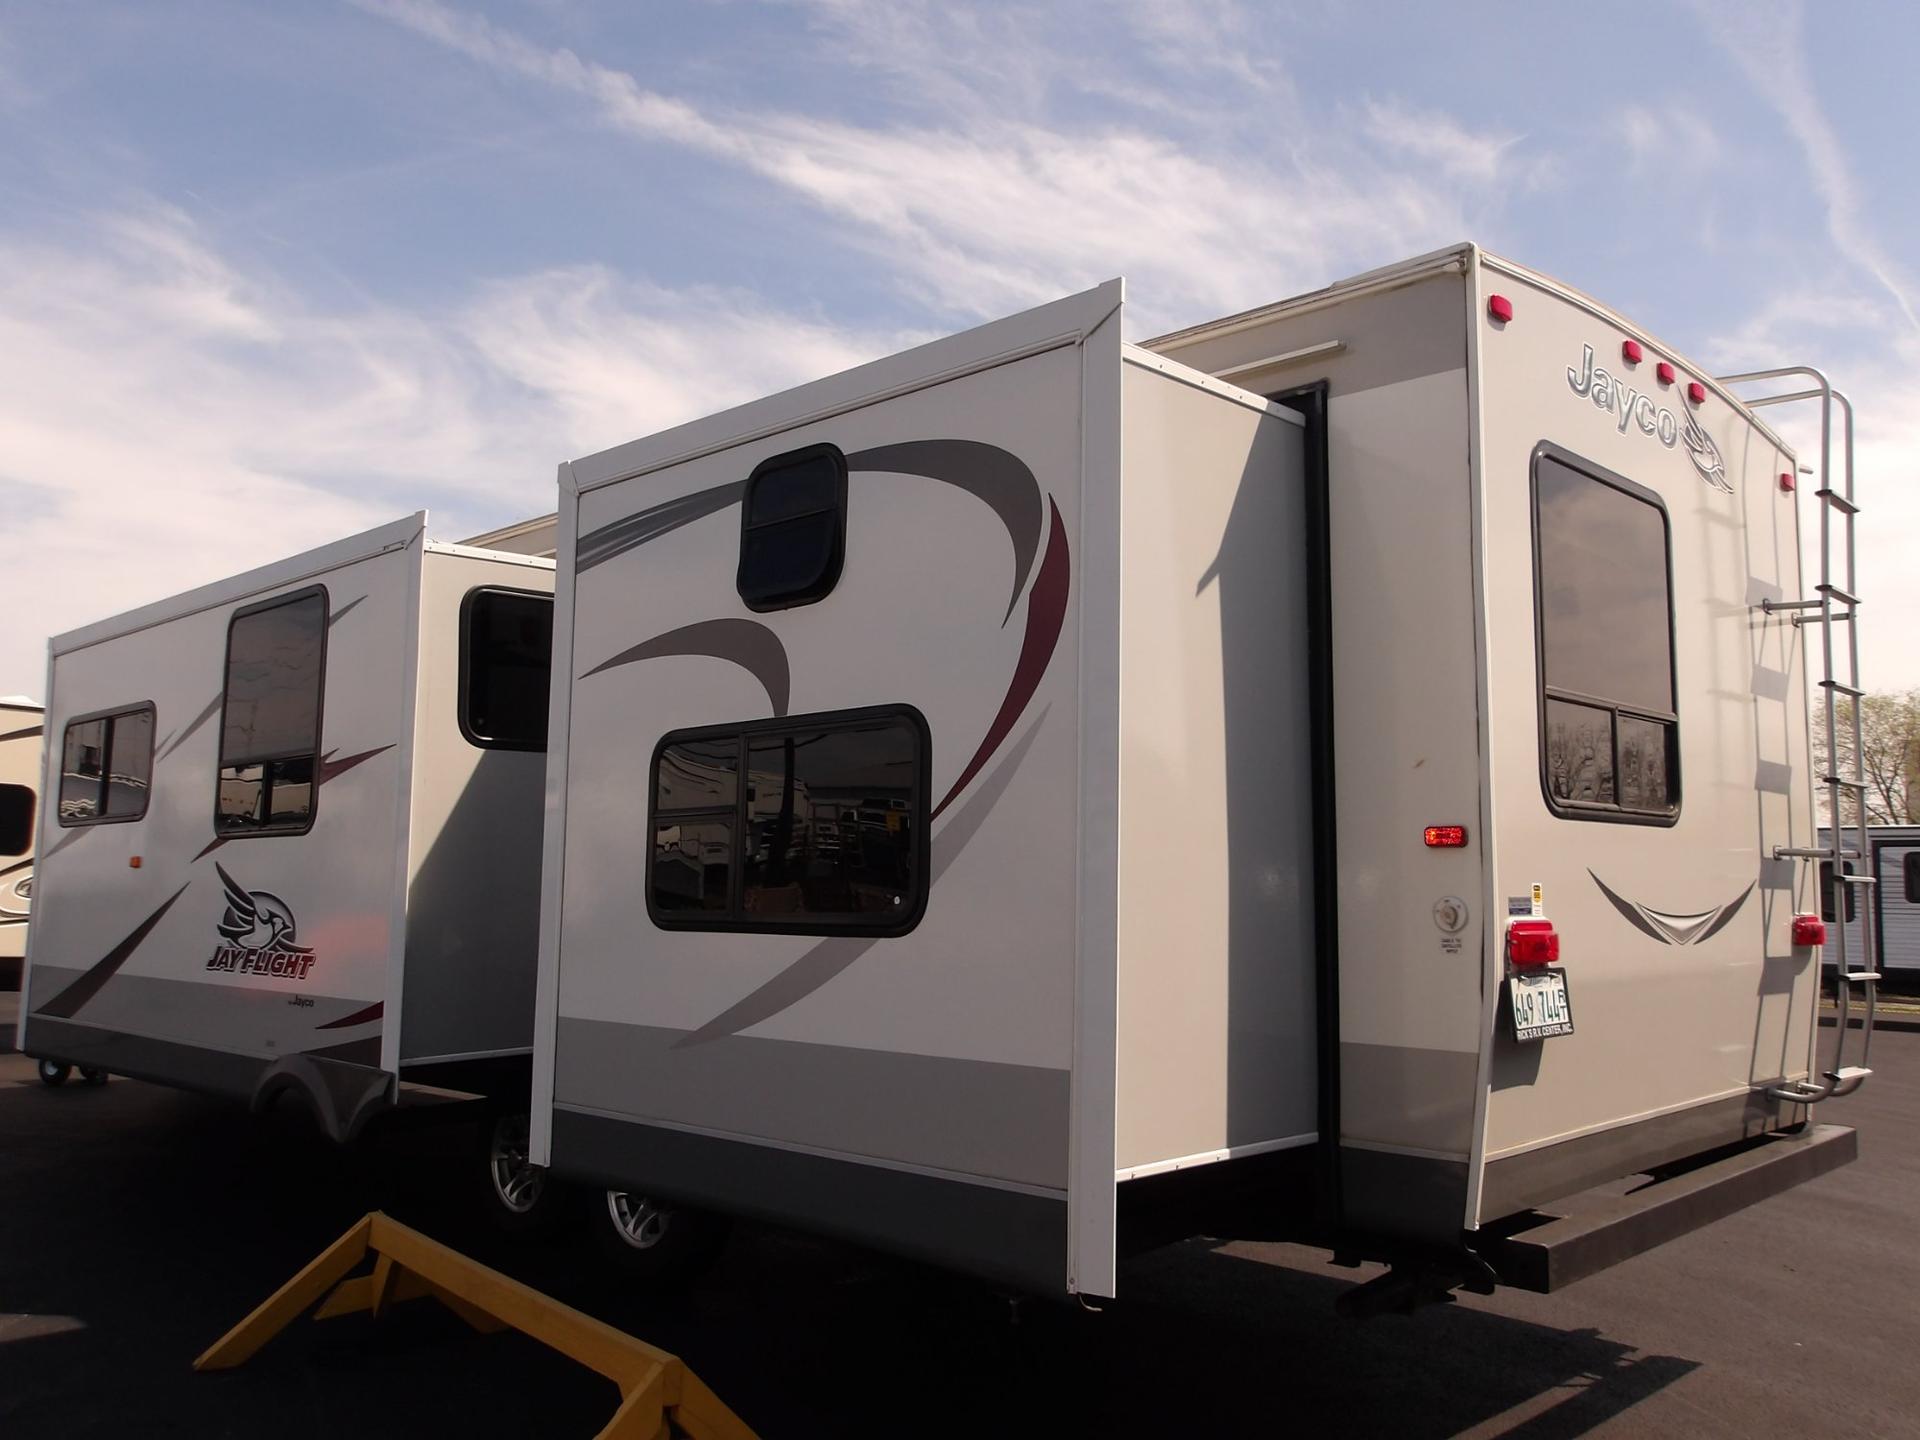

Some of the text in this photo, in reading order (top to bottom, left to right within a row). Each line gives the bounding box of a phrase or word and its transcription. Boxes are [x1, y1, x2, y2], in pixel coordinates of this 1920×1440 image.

[1567, 343, 1678, 449] Jayco
[240, 948, 316, 979] FLIGHT
[1515, 992, 1534, 1026] 649
[1538, 990, 1561, 1022] 744
